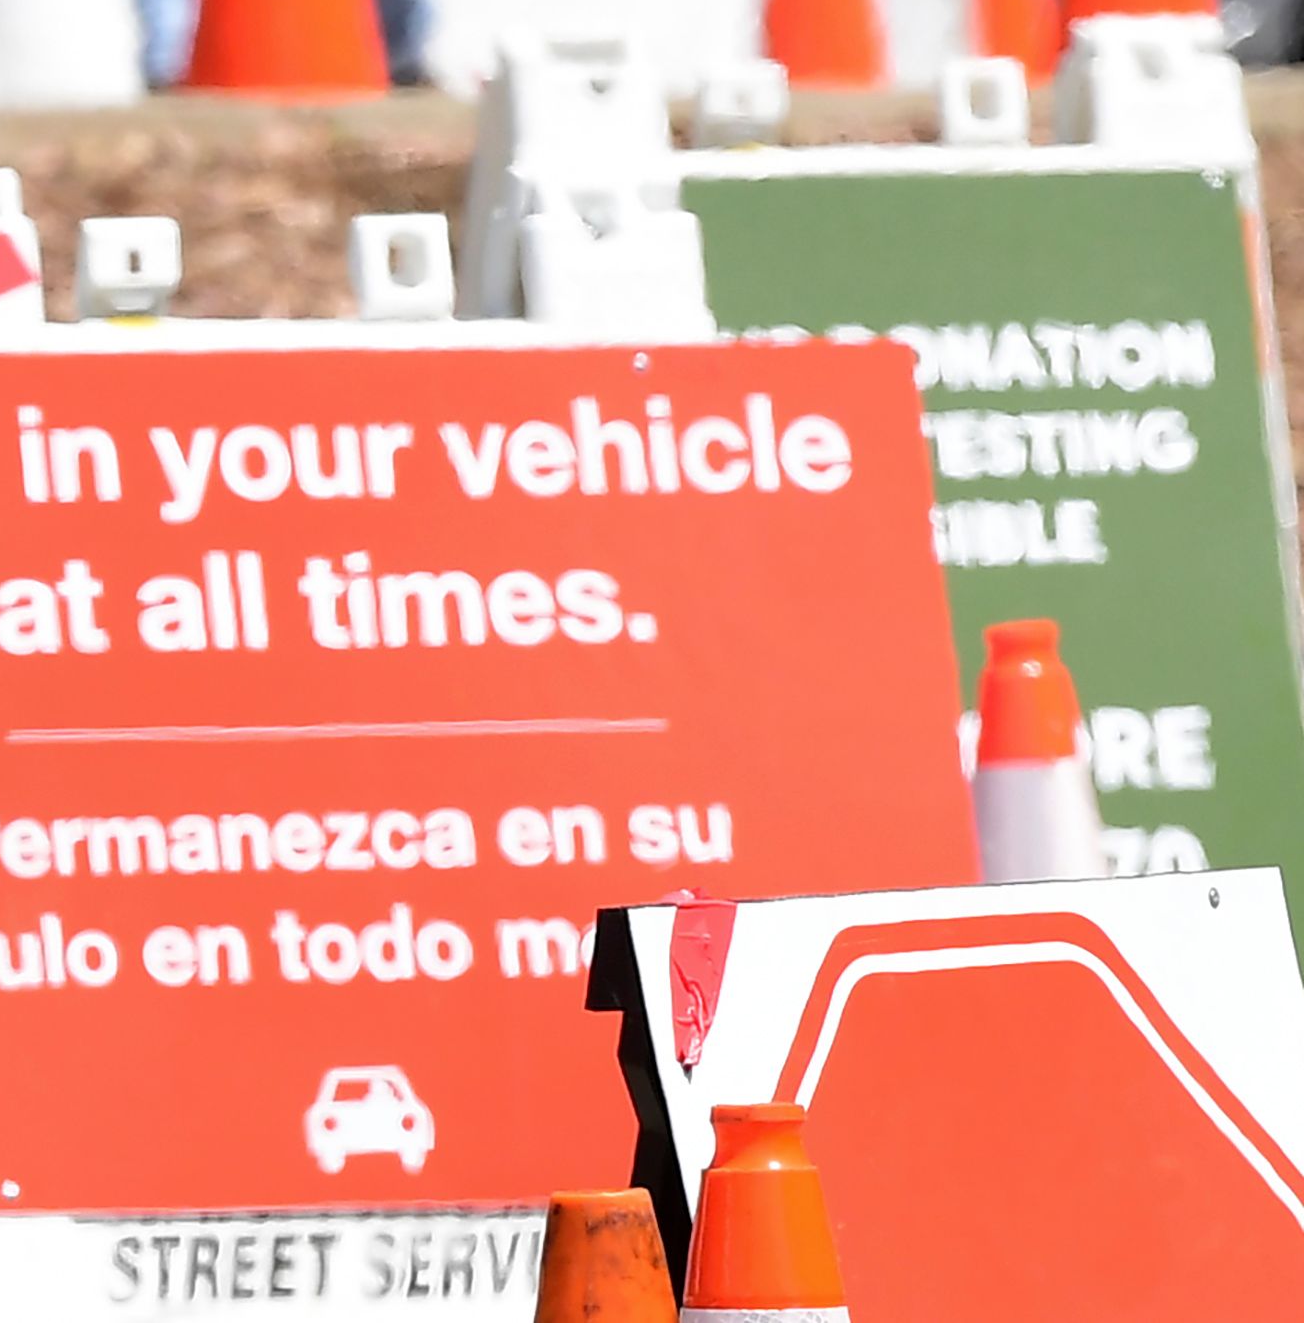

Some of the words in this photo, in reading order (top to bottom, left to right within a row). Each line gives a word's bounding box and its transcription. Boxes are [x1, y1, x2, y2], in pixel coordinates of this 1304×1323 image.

[17, 404, 123, 504] in
[148, 418, 414, 524] your
[438, 392, 854, 499] vehicle
[135, 549, 270, 652] all
[297, 550, 659, 650] times.
[496, 804, 607, 867] en
[627, 802, 734, 865] su
[142, 924, 252, 987] en
[270, 902, 474, 985] todo
[108, 1232, 342, 1303] STREET
